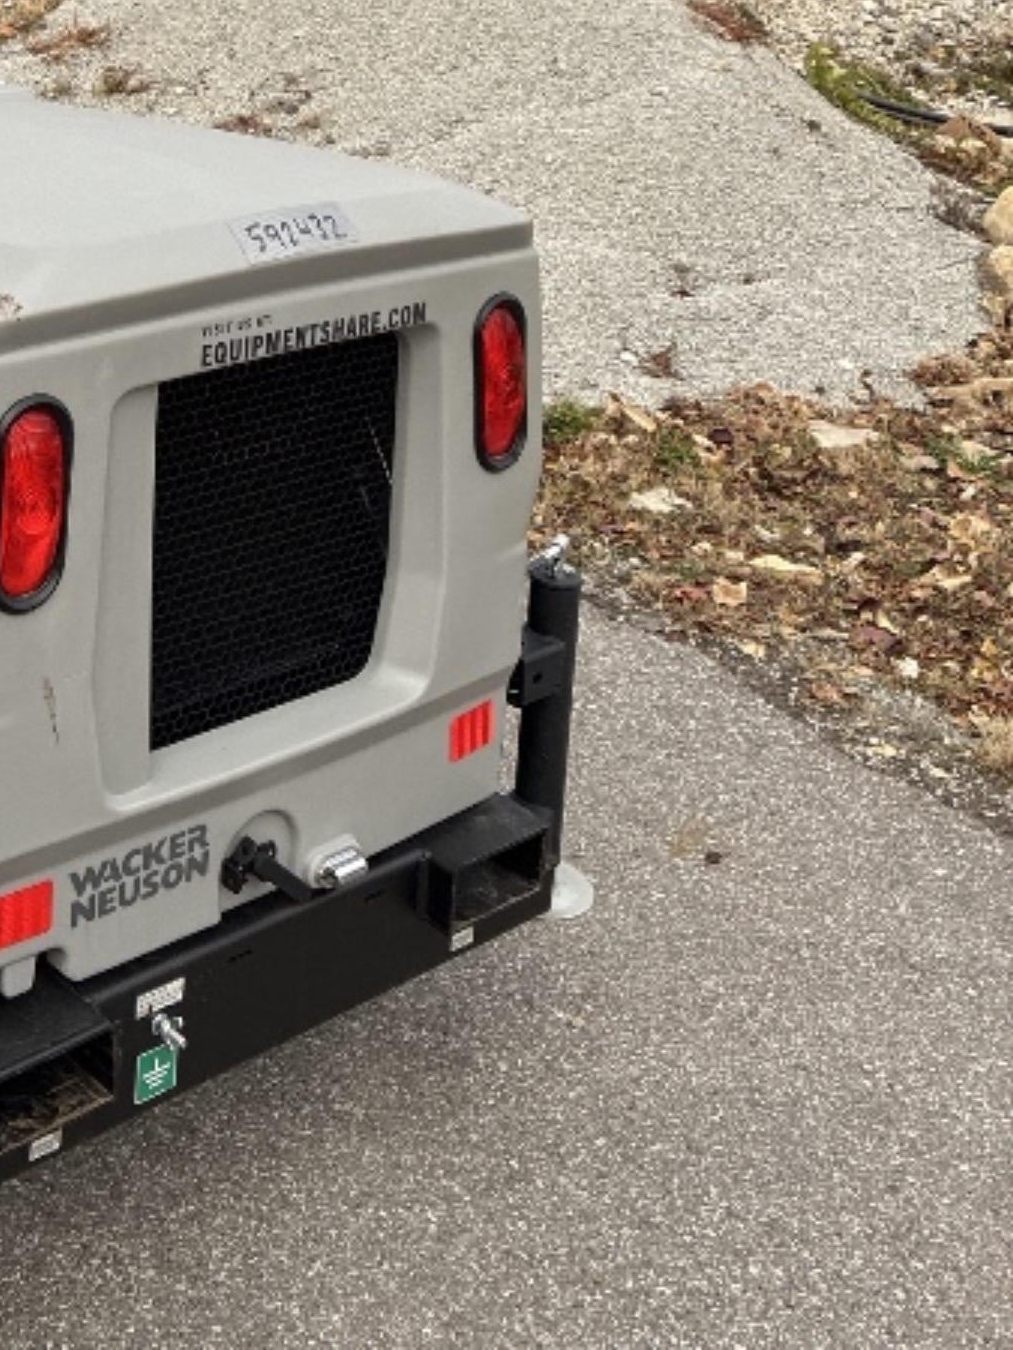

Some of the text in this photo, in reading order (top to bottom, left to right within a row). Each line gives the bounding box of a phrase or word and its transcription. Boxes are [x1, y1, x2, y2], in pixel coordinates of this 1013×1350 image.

[201, 302, 426, 367] EQUIPMENTSHARE.COM
[69, 824, 210, 897] WACKER
[70, 849, 210, 928] NEUSON
